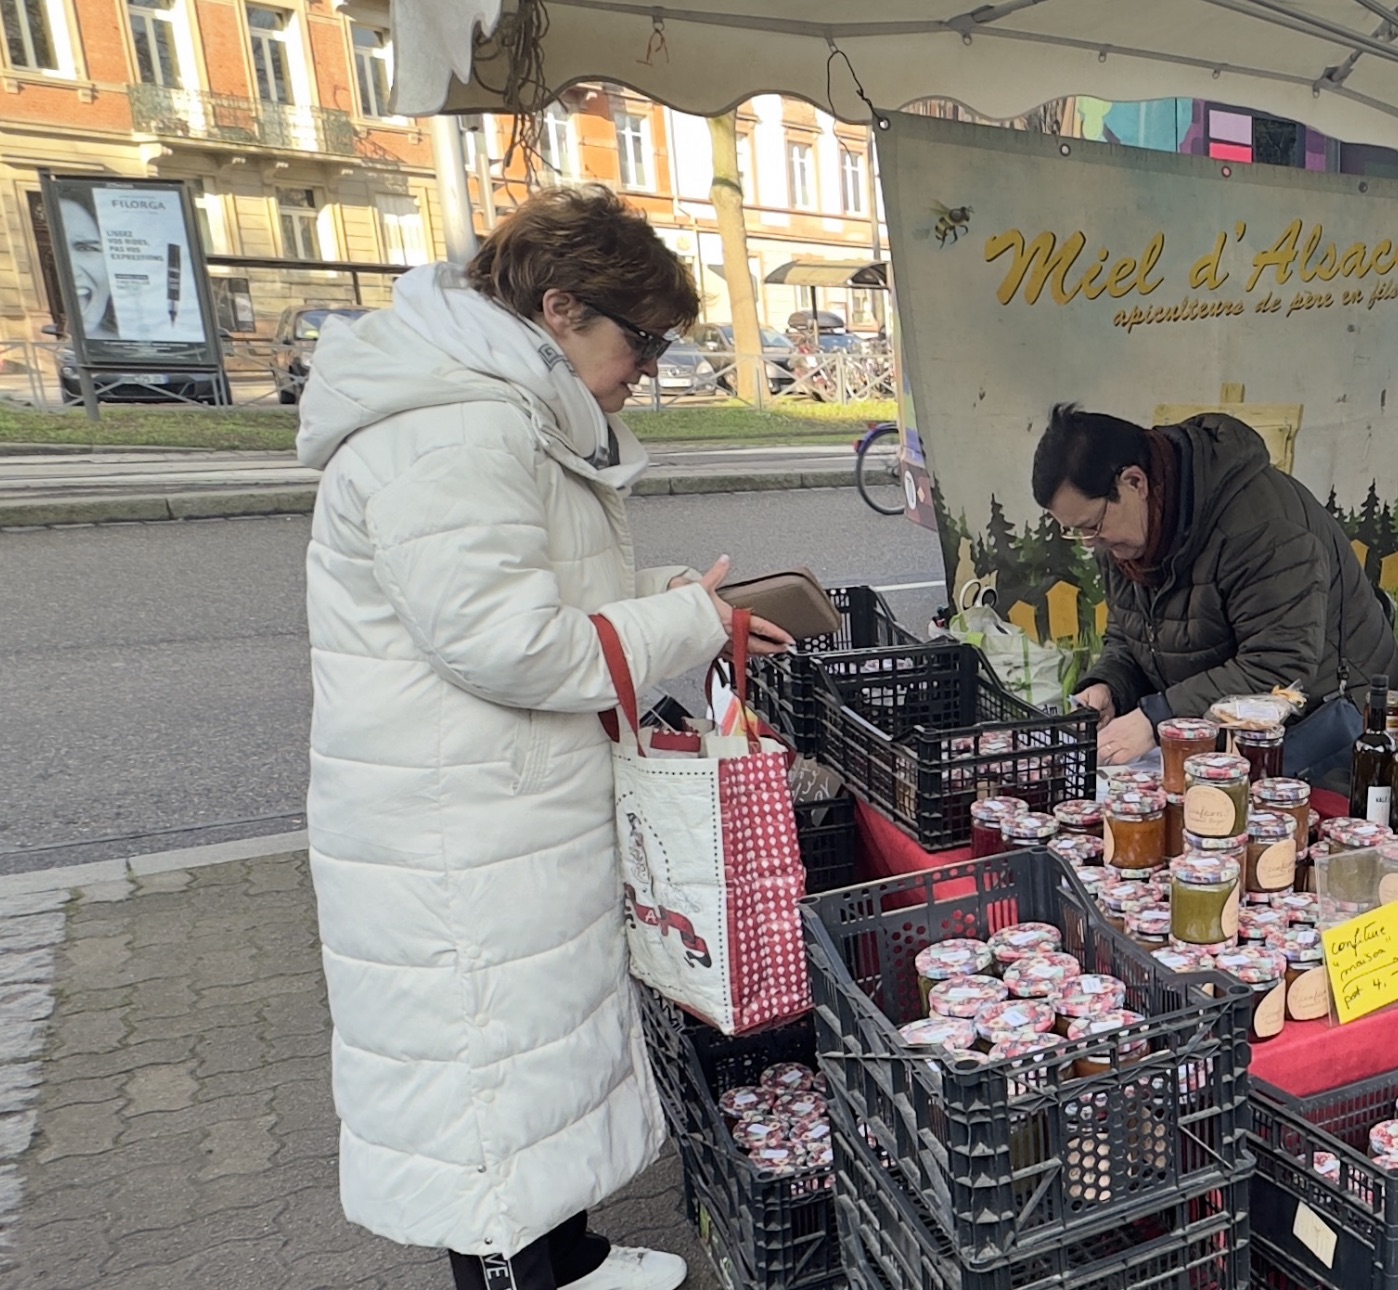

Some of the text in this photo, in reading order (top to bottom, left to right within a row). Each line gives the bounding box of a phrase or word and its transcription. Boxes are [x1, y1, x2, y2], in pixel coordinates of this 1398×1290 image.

[112, 200, 166, 210] FILORGA
[984, 229, 1165, 307] Miel
[1113, 294, 1245, 334] apiculteurs
[1255, 291, 1282, 313] de
[1286, 288, 1333, 317] père
[1342, 288, 1364, 306] en
